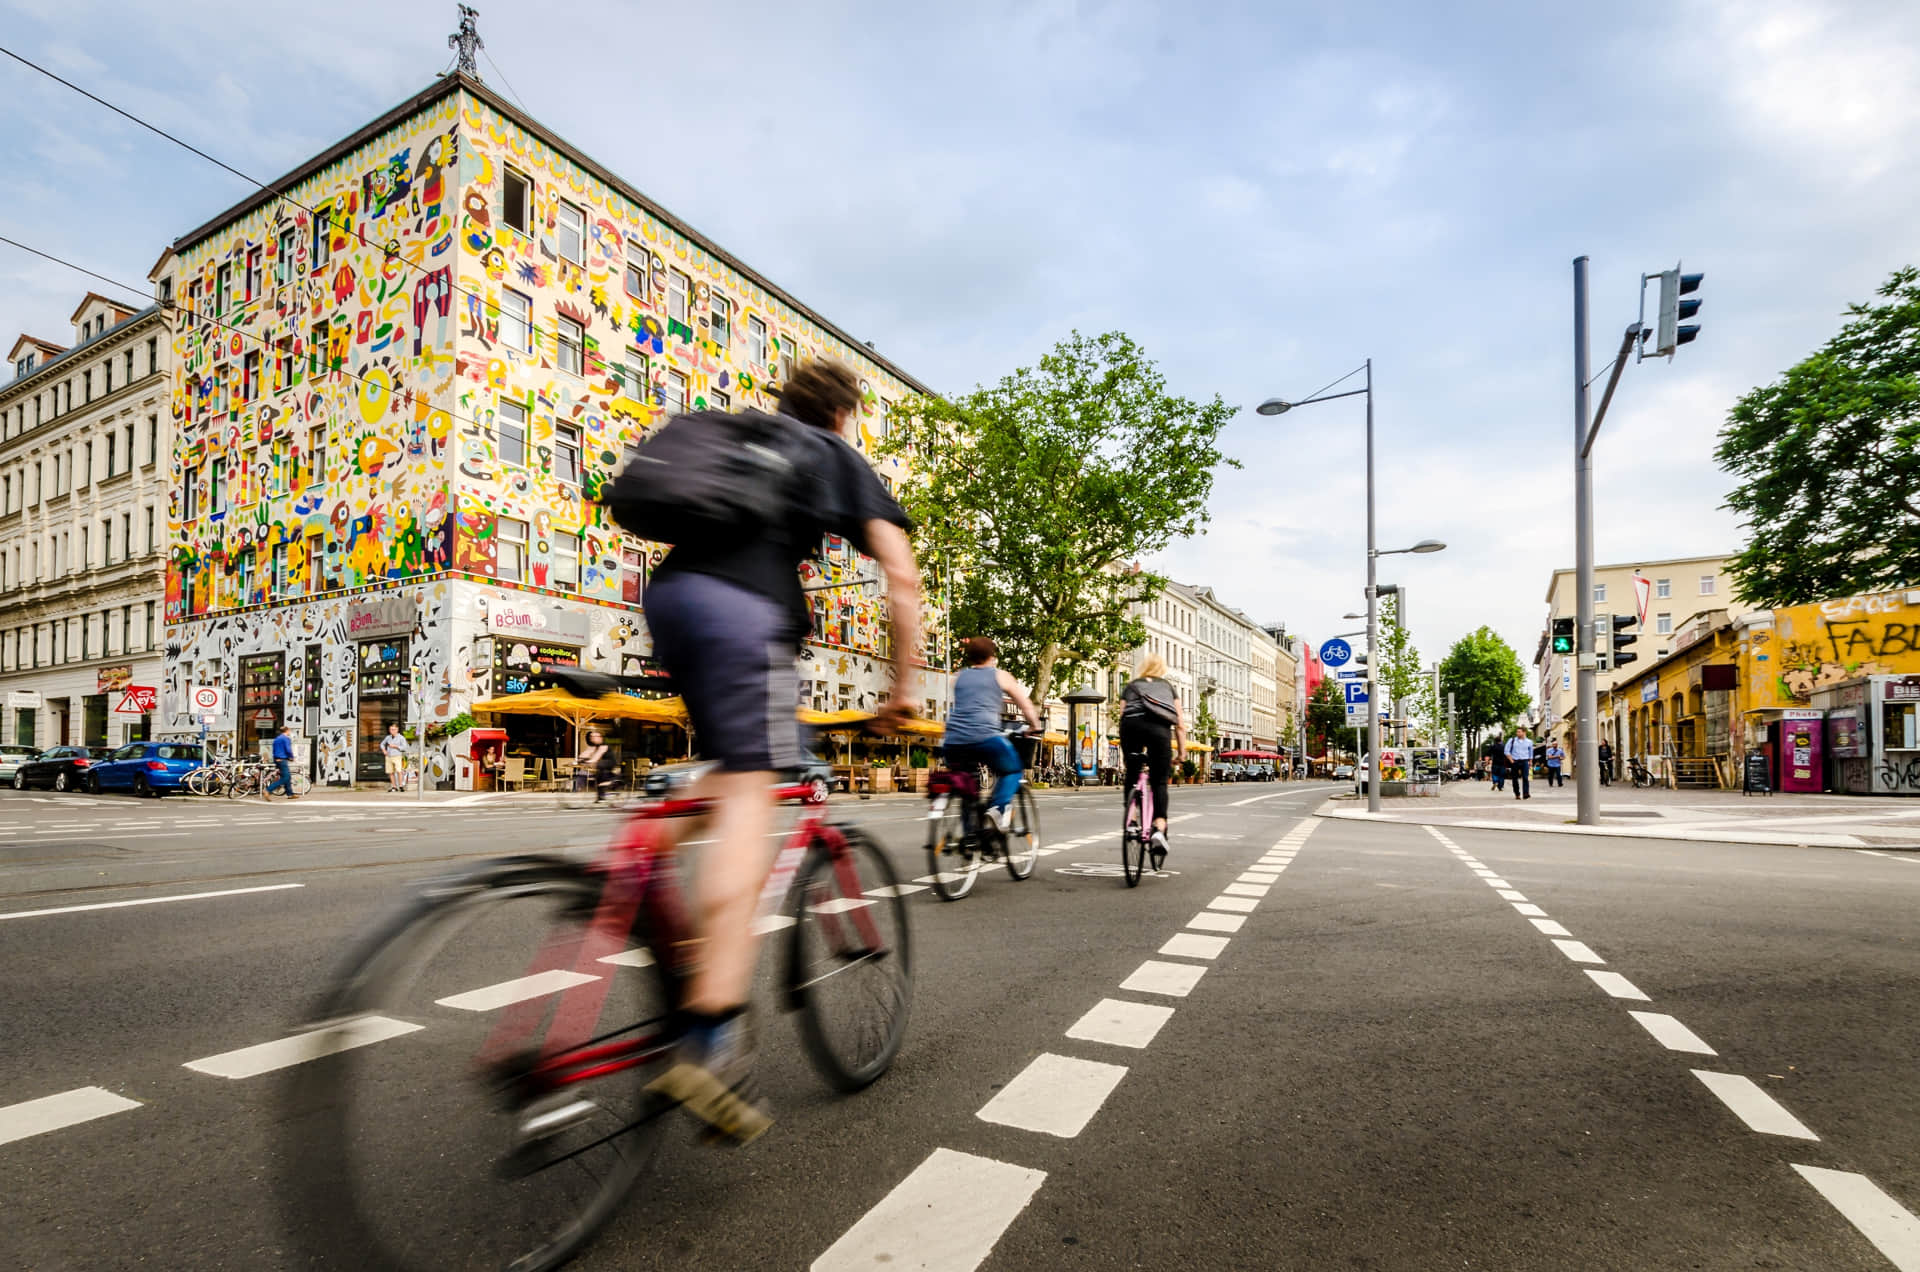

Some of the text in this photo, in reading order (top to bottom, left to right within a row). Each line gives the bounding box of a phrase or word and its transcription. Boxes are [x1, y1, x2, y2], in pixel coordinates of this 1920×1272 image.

[383, 646, 396, 659] sky
[506, 678, 528, 692] sky
[200, 693, 213, 703] 30
